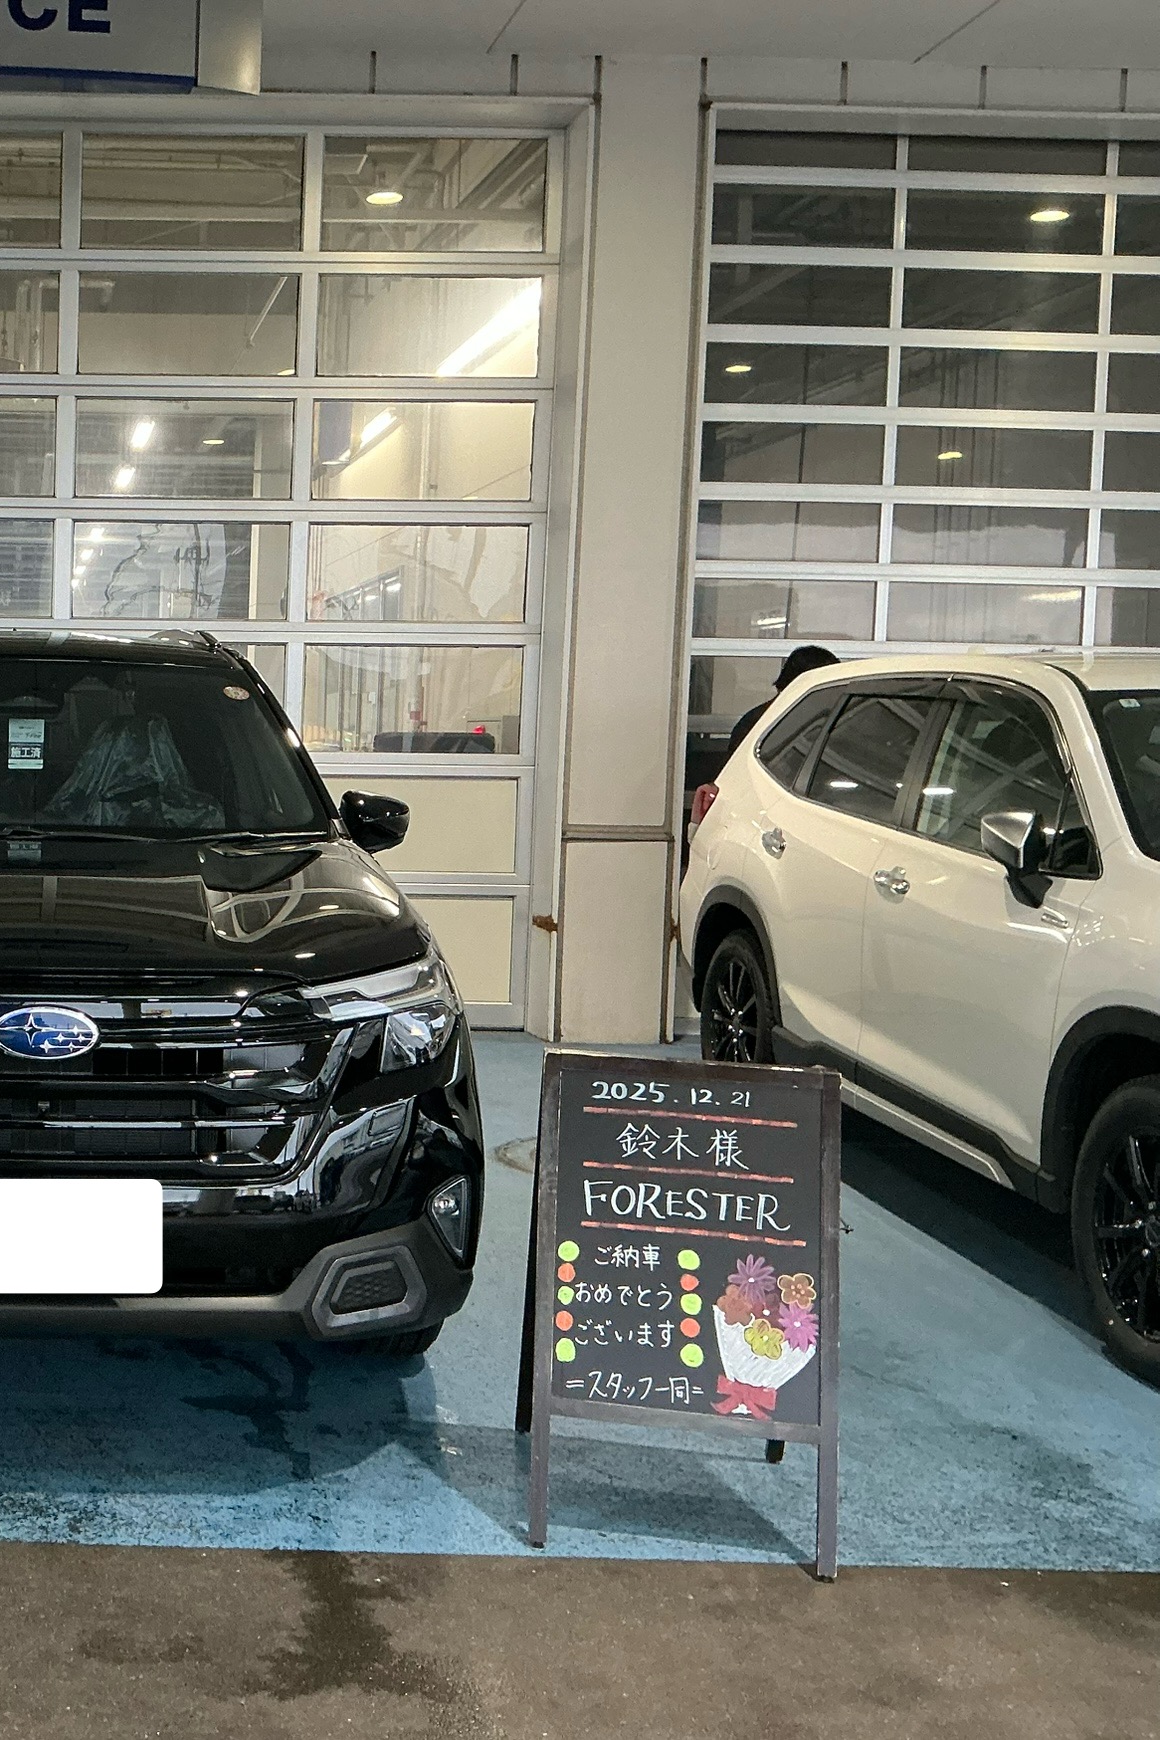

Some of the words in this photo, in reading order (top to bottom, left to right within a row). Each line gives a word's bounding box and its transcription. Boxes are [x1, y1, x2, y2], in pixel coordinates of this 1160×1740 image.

[615, 1122, 749, 1170] 鈴木様
[582, 1179, 790, 1231] FORESTER
[594, 1243, 661, 1272] ご納車
[574, 1281, 673, 1311] おめでとう
[574, 1318, 675, 1348] ございます
